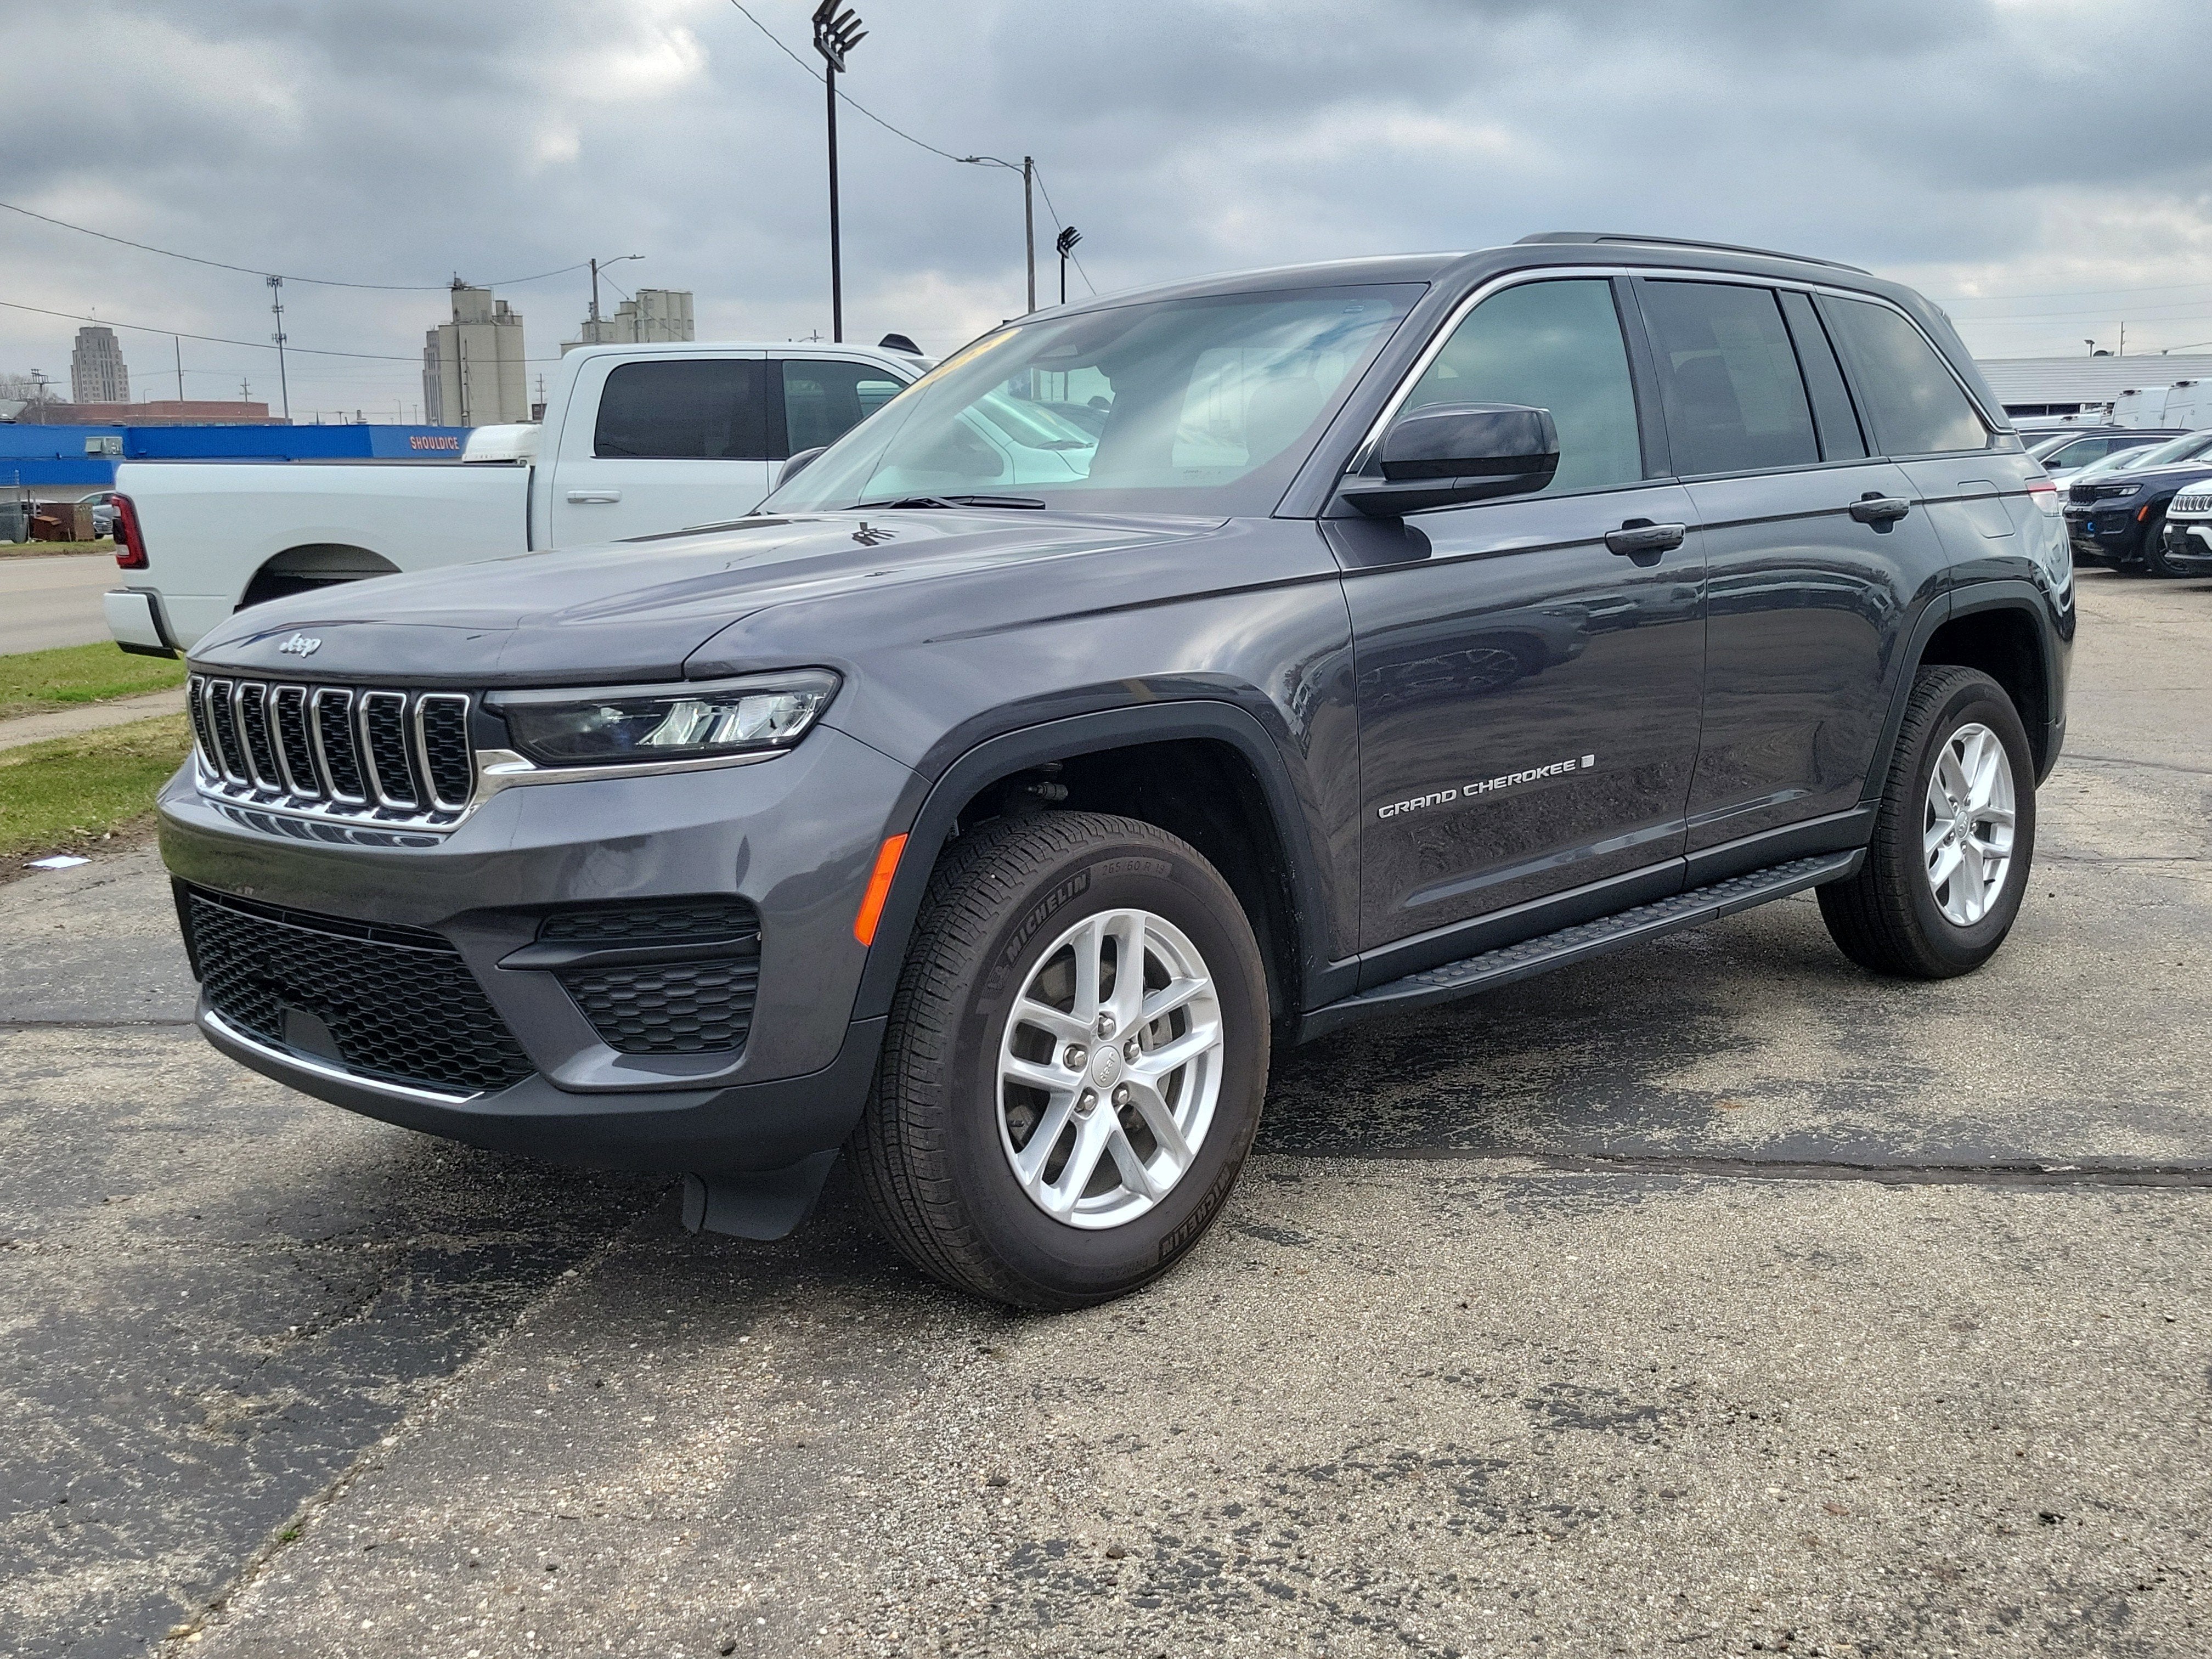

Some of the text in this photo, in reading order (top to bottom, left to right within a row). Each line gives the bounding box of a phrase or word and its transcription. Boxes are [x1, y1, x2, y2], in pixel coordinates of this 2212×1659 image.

[410, 436, 460, 449] SHOULDICE
[279, 633, 322, 658] Jeep
[1378, 759, 1576, 819] GRAND CHEROKEE
[1006, 874, 1086, 963] MICHELIN
[1100, 1052, 1114, 1082] Jeep
[1162, 1165, 1231, 1256] MICHELIN
